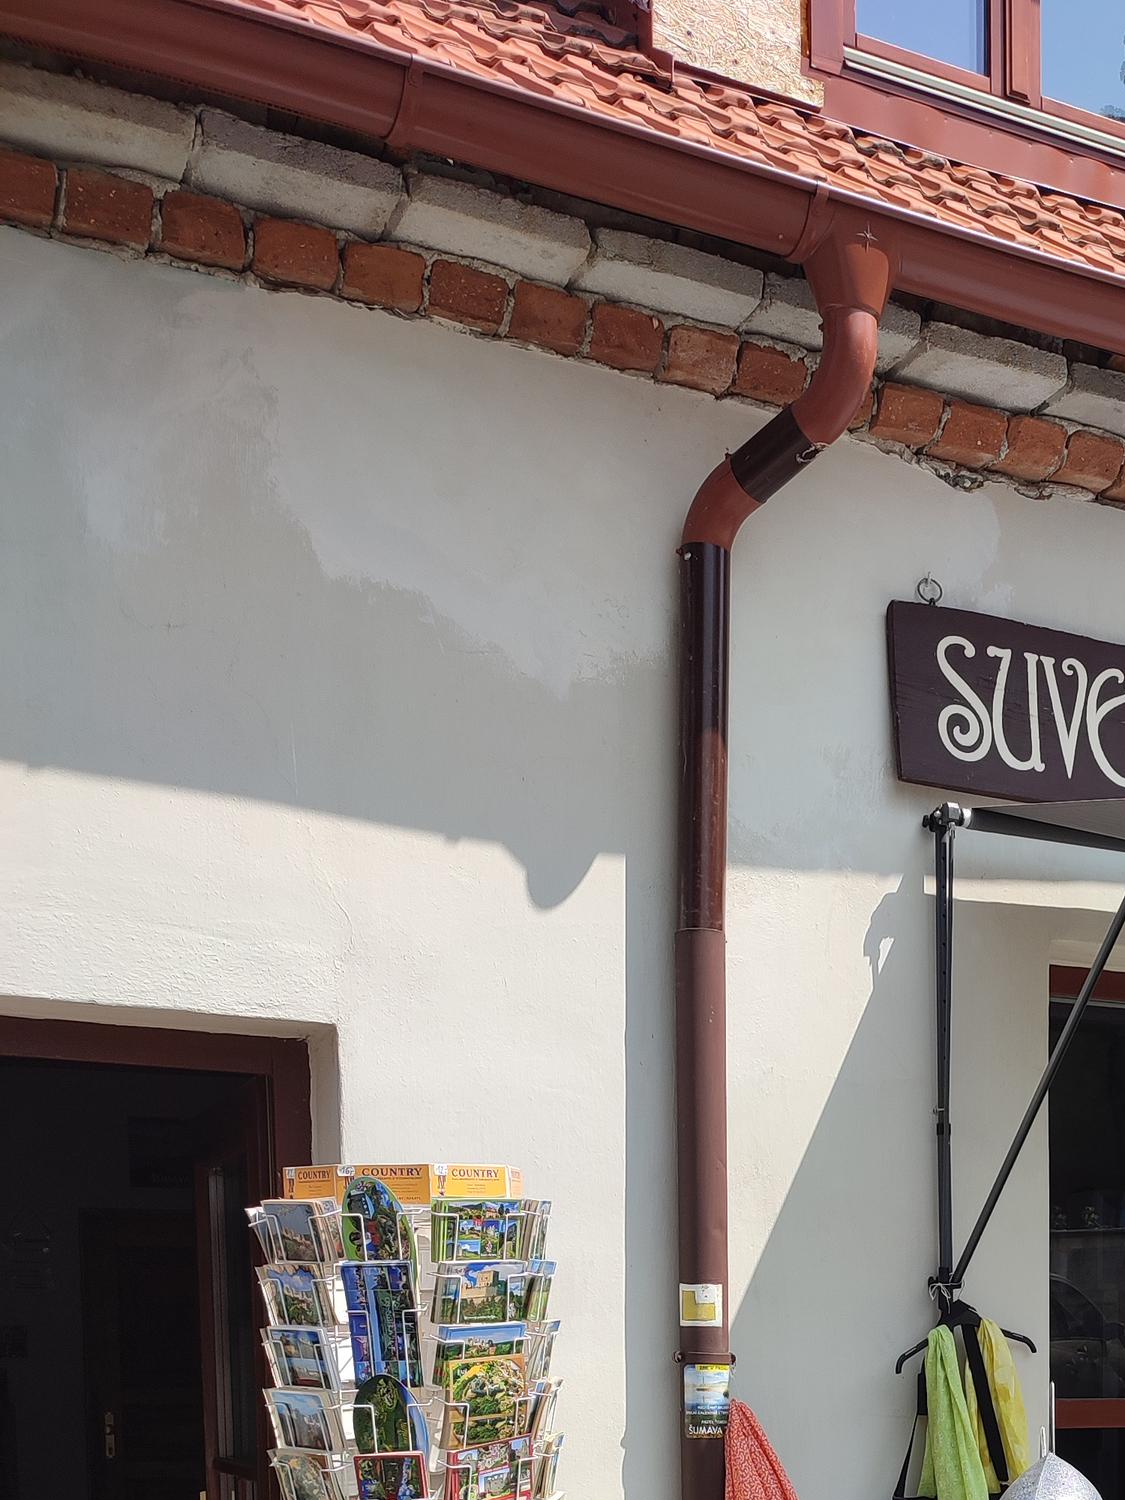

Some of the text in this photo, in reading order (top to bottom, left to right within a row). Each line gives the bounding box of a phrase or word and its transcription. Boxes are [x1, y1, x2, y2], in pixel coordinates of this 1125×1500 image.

[298, 1170, 331, 1180] COUNTRY
[362, 1168, 422, 1176] COUNTRY
[451, 1168, 500, 1178] COUNTRY
[689, 1424, 723, 1434] ŠUMAVA
